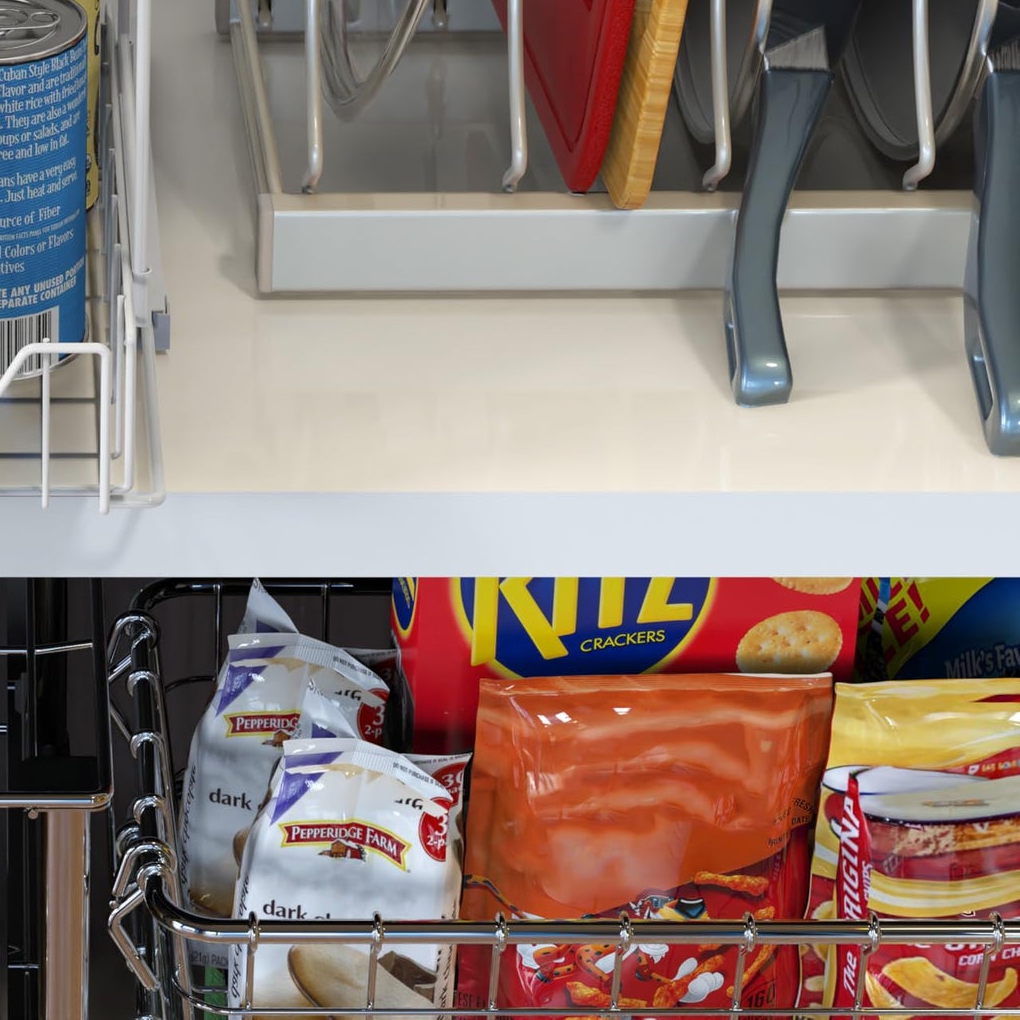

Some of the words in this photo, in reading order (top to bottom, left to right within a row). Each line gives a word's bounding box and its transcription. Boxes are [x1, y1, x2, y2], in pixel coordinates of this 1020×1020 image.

[28, 64, 50, 79] Style
[28, 79, 45, 94] and
[45, 76, 60, 90] are
[25, 96, 43, 110] rice
[43, 89, 61, 106] with
[5, 114, 30, 129] They
[30, 112, 46, 125] are
[46, 106, 61, 120] also
[20, 131, 32, 142] or
[15, 145, 33, 159] and
[34, 142, 48, 156] low
[16, 171, 39, 186] have
[39, 170, 45, 181] a
[45, 164, 63, 178] very
[4, 188, 24, 203] Just
[26, 183, 45, 200] heat
[46, 177, 62, 194] and
[24, 210, 35, 225] of
[38, 205, 61, 222] Fiber
[4, 243, 35, 259] Colors
[36, 241, 47, 253] or
[10, 283, 31, 297] ANY
[33, 273, 64, 293] UNUSED
[579, 629, 666, 654] CRACKERS
[208, 788, 252, 811] dark
[291, 825, 363, 841] PEPPERIDGE
[365, 827, 397, 857] FARM
[262, 899, 308, 920] dark
